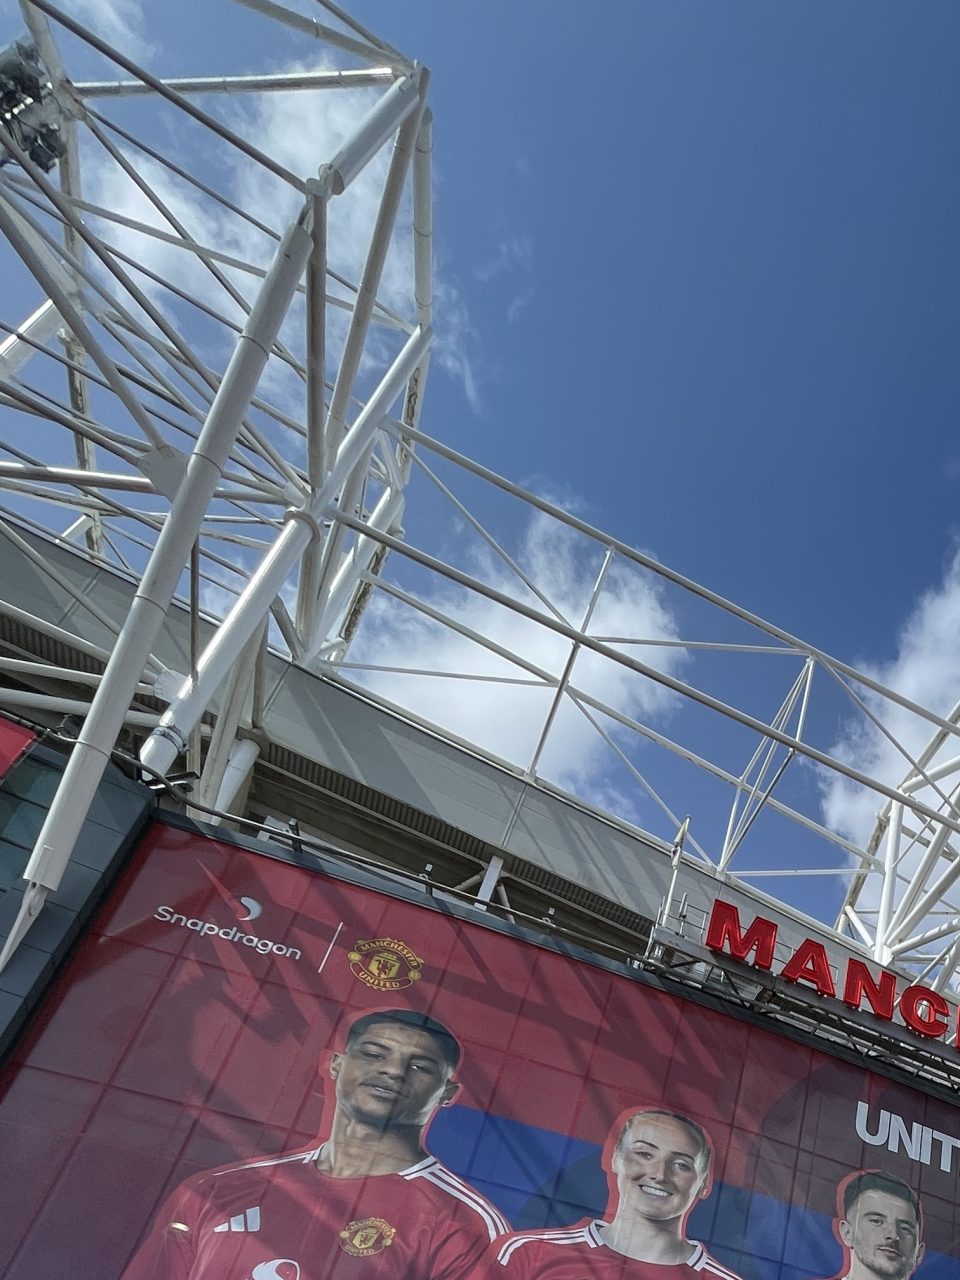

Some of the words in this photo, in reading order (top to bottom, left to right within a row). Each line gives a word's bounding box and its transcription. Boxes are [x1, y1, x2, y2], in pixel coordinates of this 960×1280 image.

[153, 905, 302, 960] Snapdragon
[360, 941, 418, 967] MANCHESTER
[358, 971, 400, 988] UNITED
